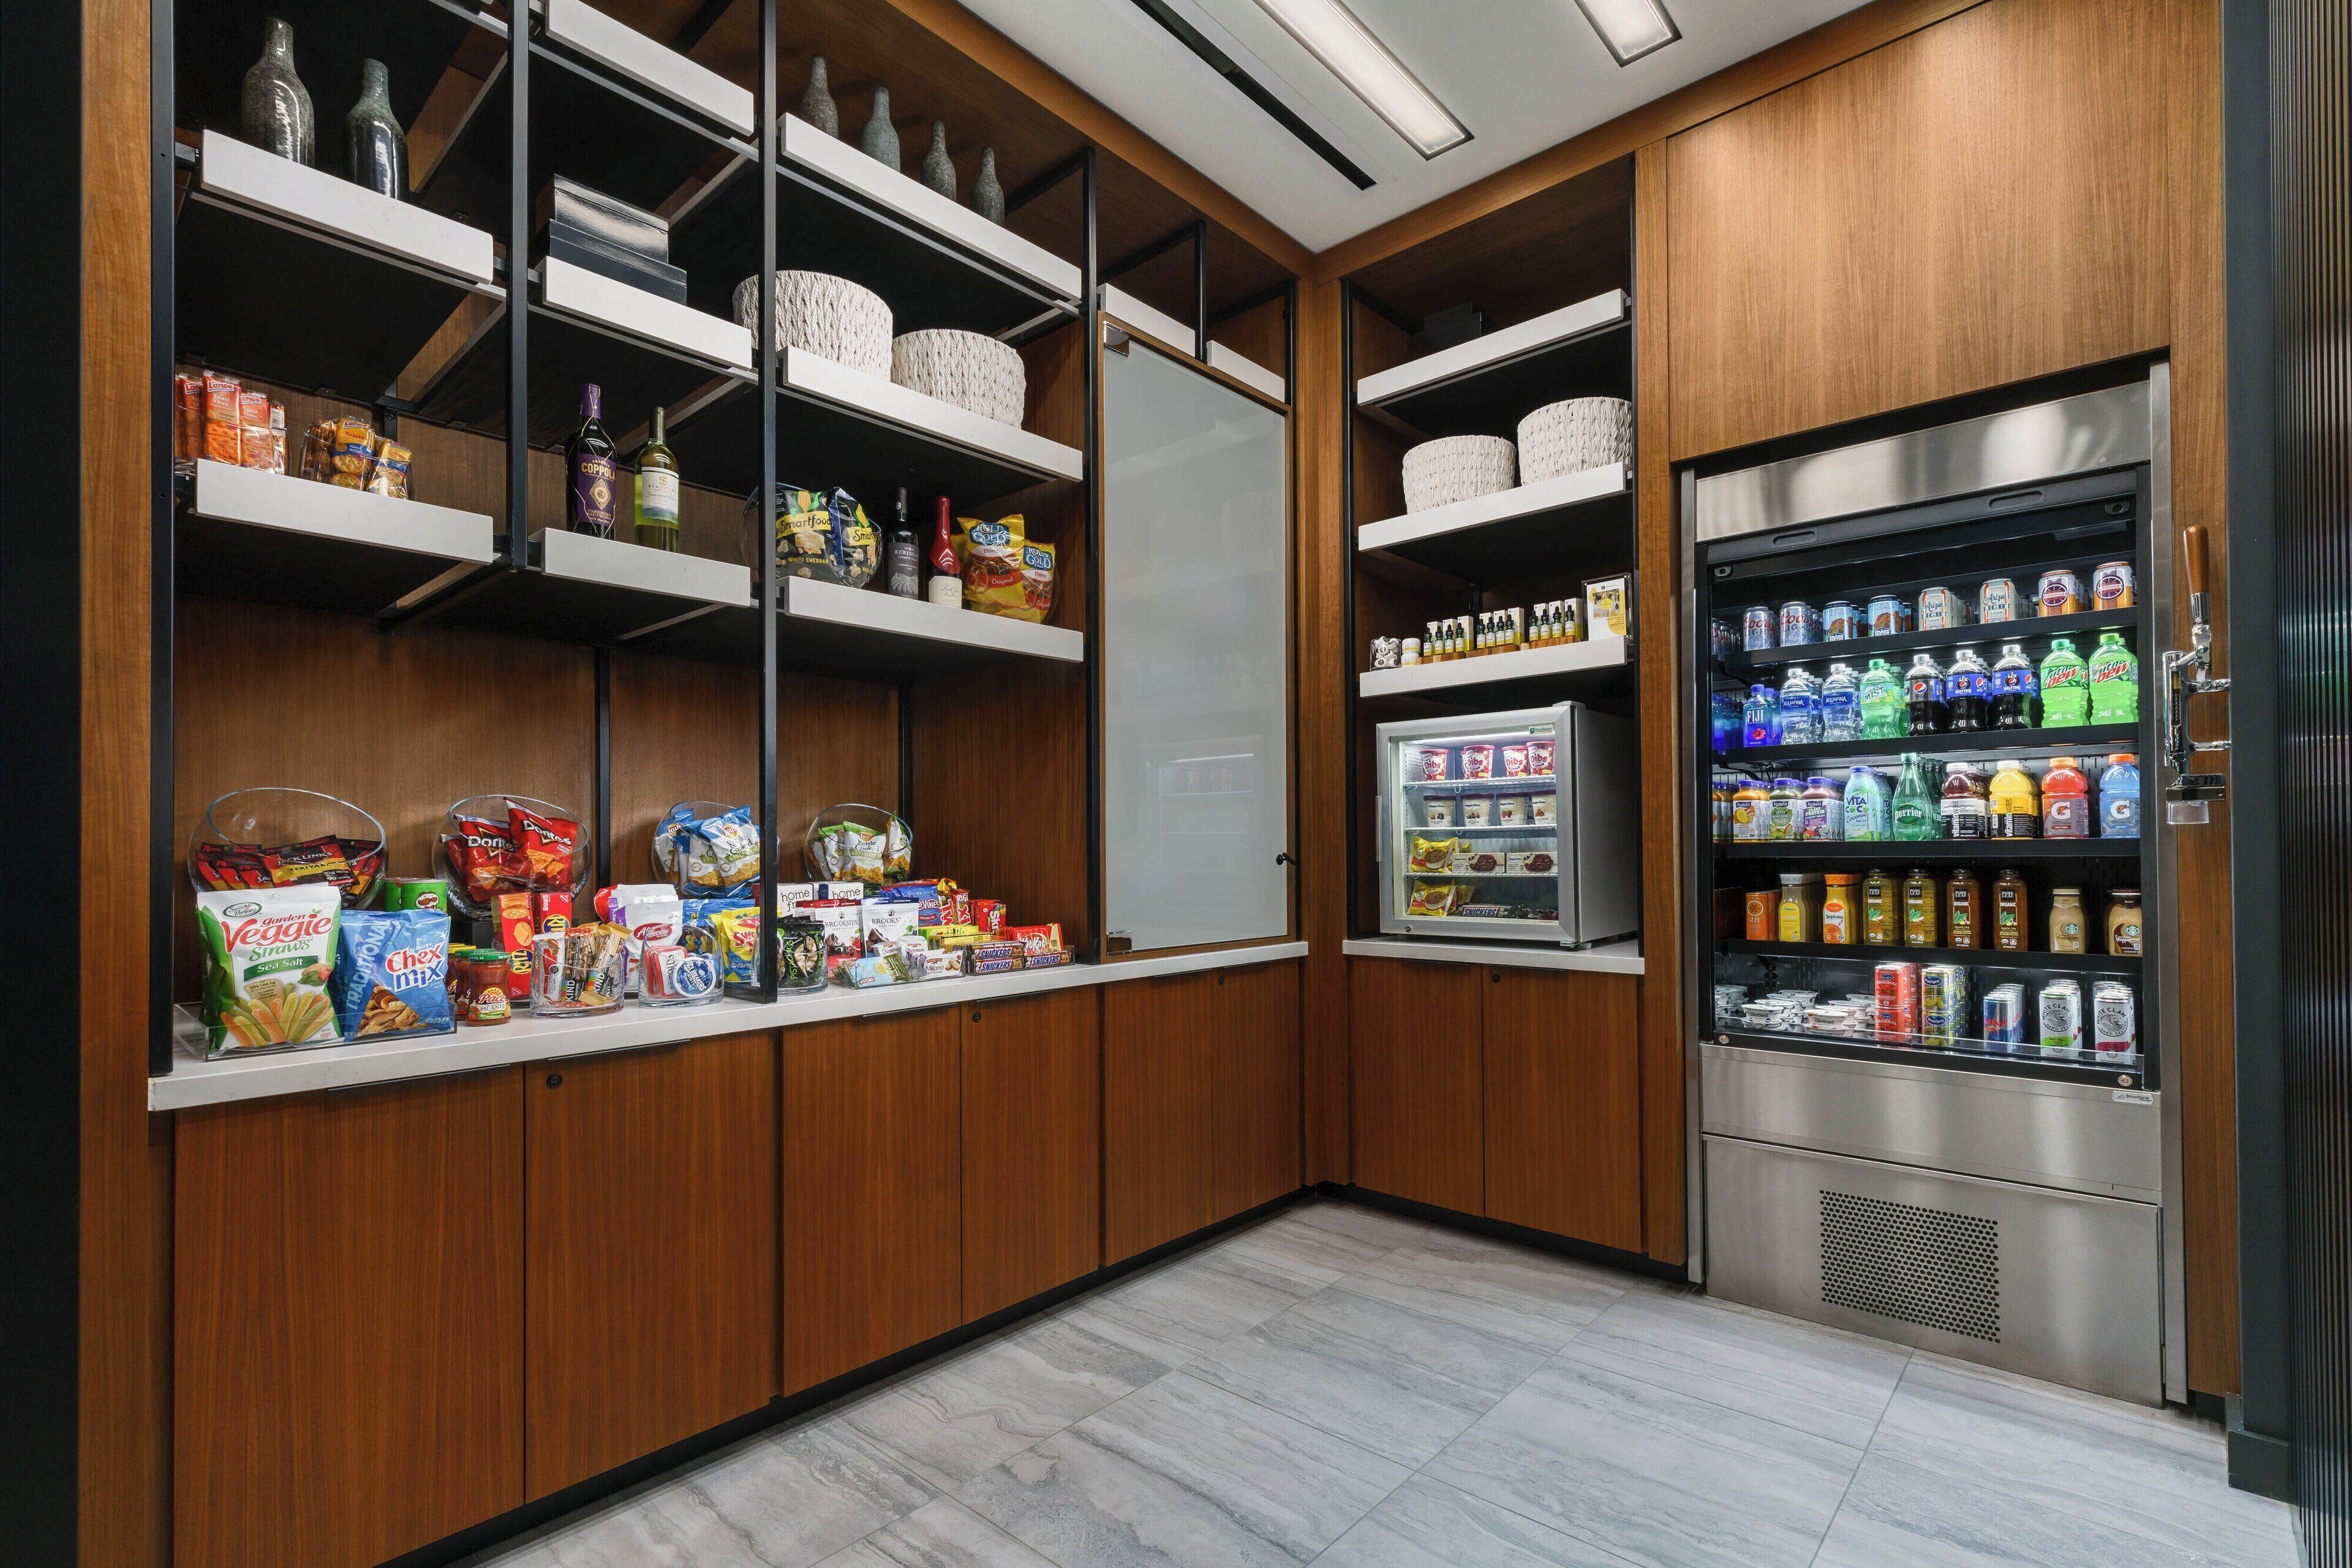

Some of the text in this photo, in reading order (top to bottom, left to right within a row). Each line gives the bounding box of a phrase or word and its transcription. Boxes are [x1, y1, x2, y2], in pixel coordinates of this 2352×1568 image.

[209, 381, 234, 390] Lance
[345, 431, 365, 440] Toasty
[972, 531, 1006, 544] GOLD
[1028, 546, 1048, 558] ROLD
[1026, 554, 1052, 569] GOLD
[991, 576, 1014, 586] Original
[2046, 668, 2078, 688] DEW
[2096, 663, 2128, 684] DEW
[1825, 695, 1849, 704] AQUAFINA
[1864, 690, 1884, 703] MIST
[1747, 710, 1764, 722] FIJI
[1468, 758, 1483, 766] Dibs
[1506, 756, 1523, 766] Dibs
[1531, 753, 1548, 763] Dibs
[1424, 760, 1442, 770] Dibs
[1846, 796, 1867, 805] VITA
[1894, 807, 1923, 823] perrier
[2050, 801, 2071, 820] G
[2110, 799, 2130, 820] G
[1846, 812, 1868, 824] Coconut
[522, 820, 572, 845] Doritos
[288, 862, 330, 872] TERIYAK
[781, 889, 810, 902] home
[832, 888, 861, 899] home
[228, 903, 252, 913] Sensible
[234, 907, 258, 917] Portions
[786, 901, 797, 912] fr
[1463, 907, 1497, 917] SNICKERS
[260, 913, 306, 927] garden
[220, 916, 333, 954] Veggie
[249, 939, 311, 962] Straws
[980, 949, 1011, 959] SNICKERS
[257, 957, 304, 973] Sea Salt
[386, 944, 444, 973] Chex
[511, 950, 532, 974] RITZ
[785, 940, 799, 980] PISTACHIOS
[1027, 954, 1060, 967] 2 SNICKERS
[981, 960, 1012, 972] SNICKERS
[394, 960, 443, 990] mix
[690, 969, 707, 992] BREAKERS
[594, 973, 606, 993] KIND
[565, 980, 575, 1002] KIND
[2041, 1003, 2072, 1020] WHITE CLAW
[2097, 1007, 2127, 1024] WHITE CLAW
[2100, 1027, 2113, 1035] HARD
